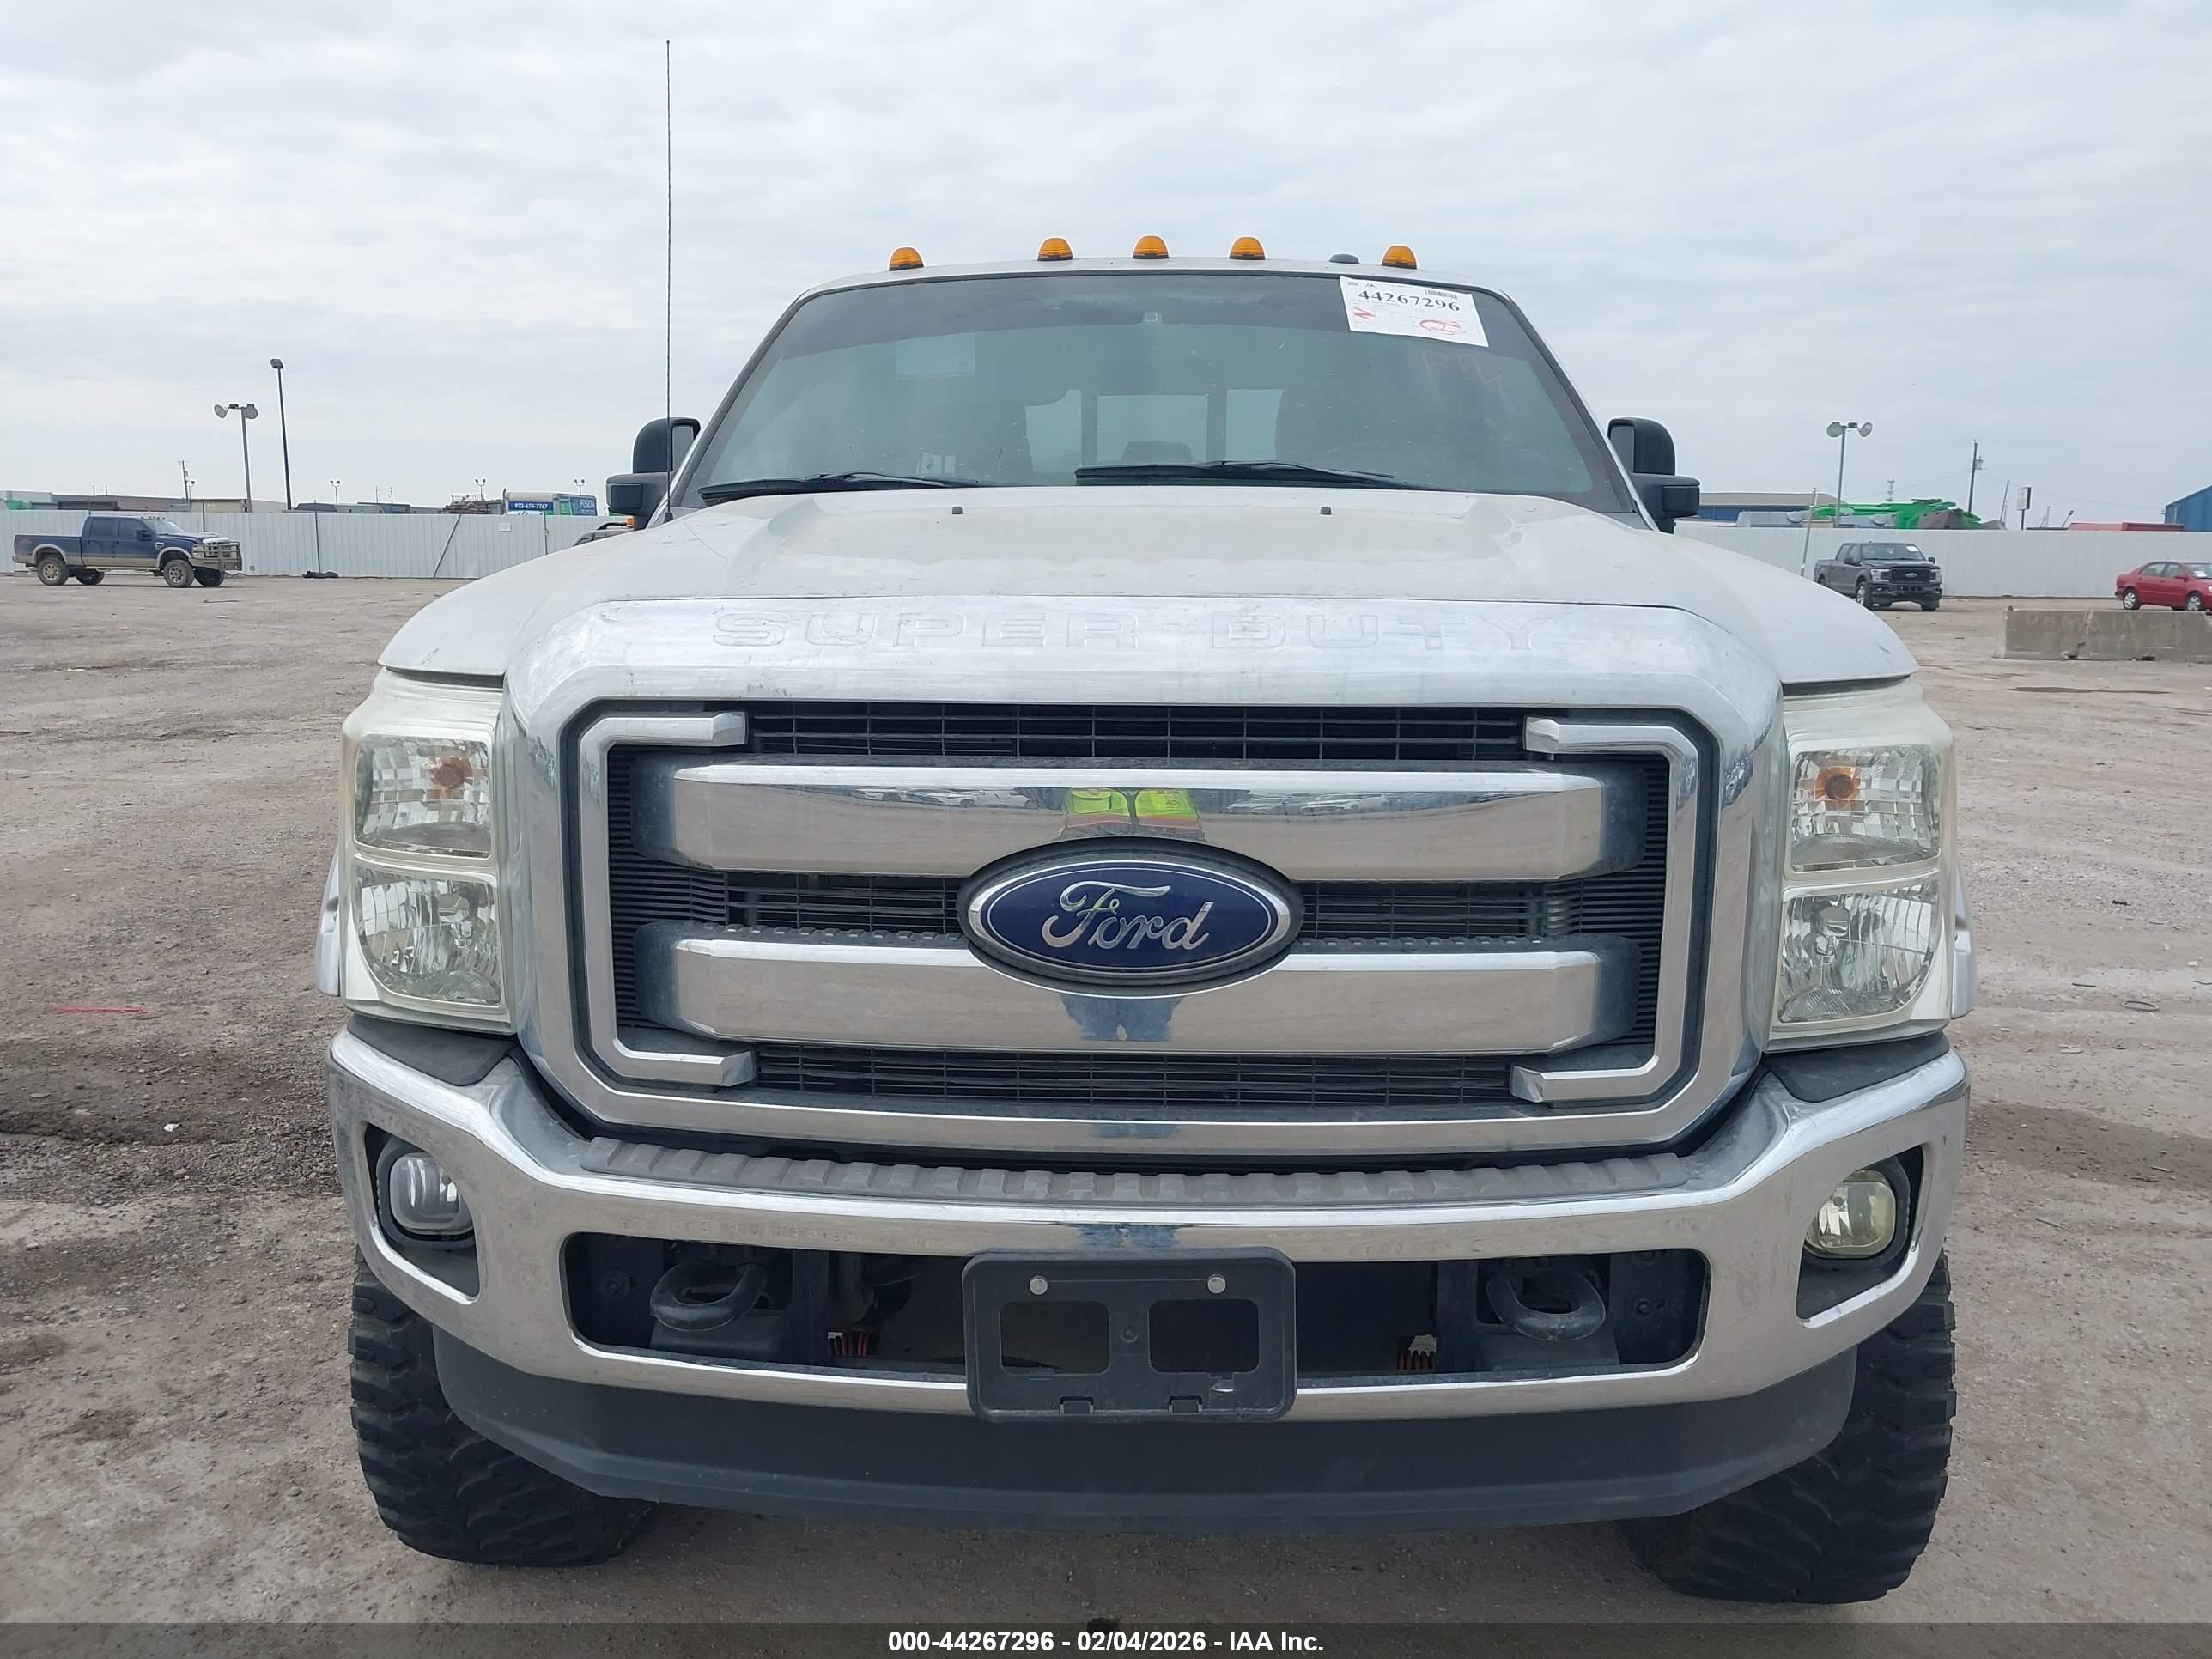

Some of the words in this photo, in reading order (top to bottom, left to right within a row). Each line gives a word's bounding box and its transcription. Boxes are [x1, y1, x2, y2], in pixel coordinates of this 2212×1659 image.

[1358, 290, 1460, 312] 44267296
[712, 611, 1140, 650] SUPER
[1209, 611, 1556, 650] DUTY
[1042, 880, 1213, 951] Ford
